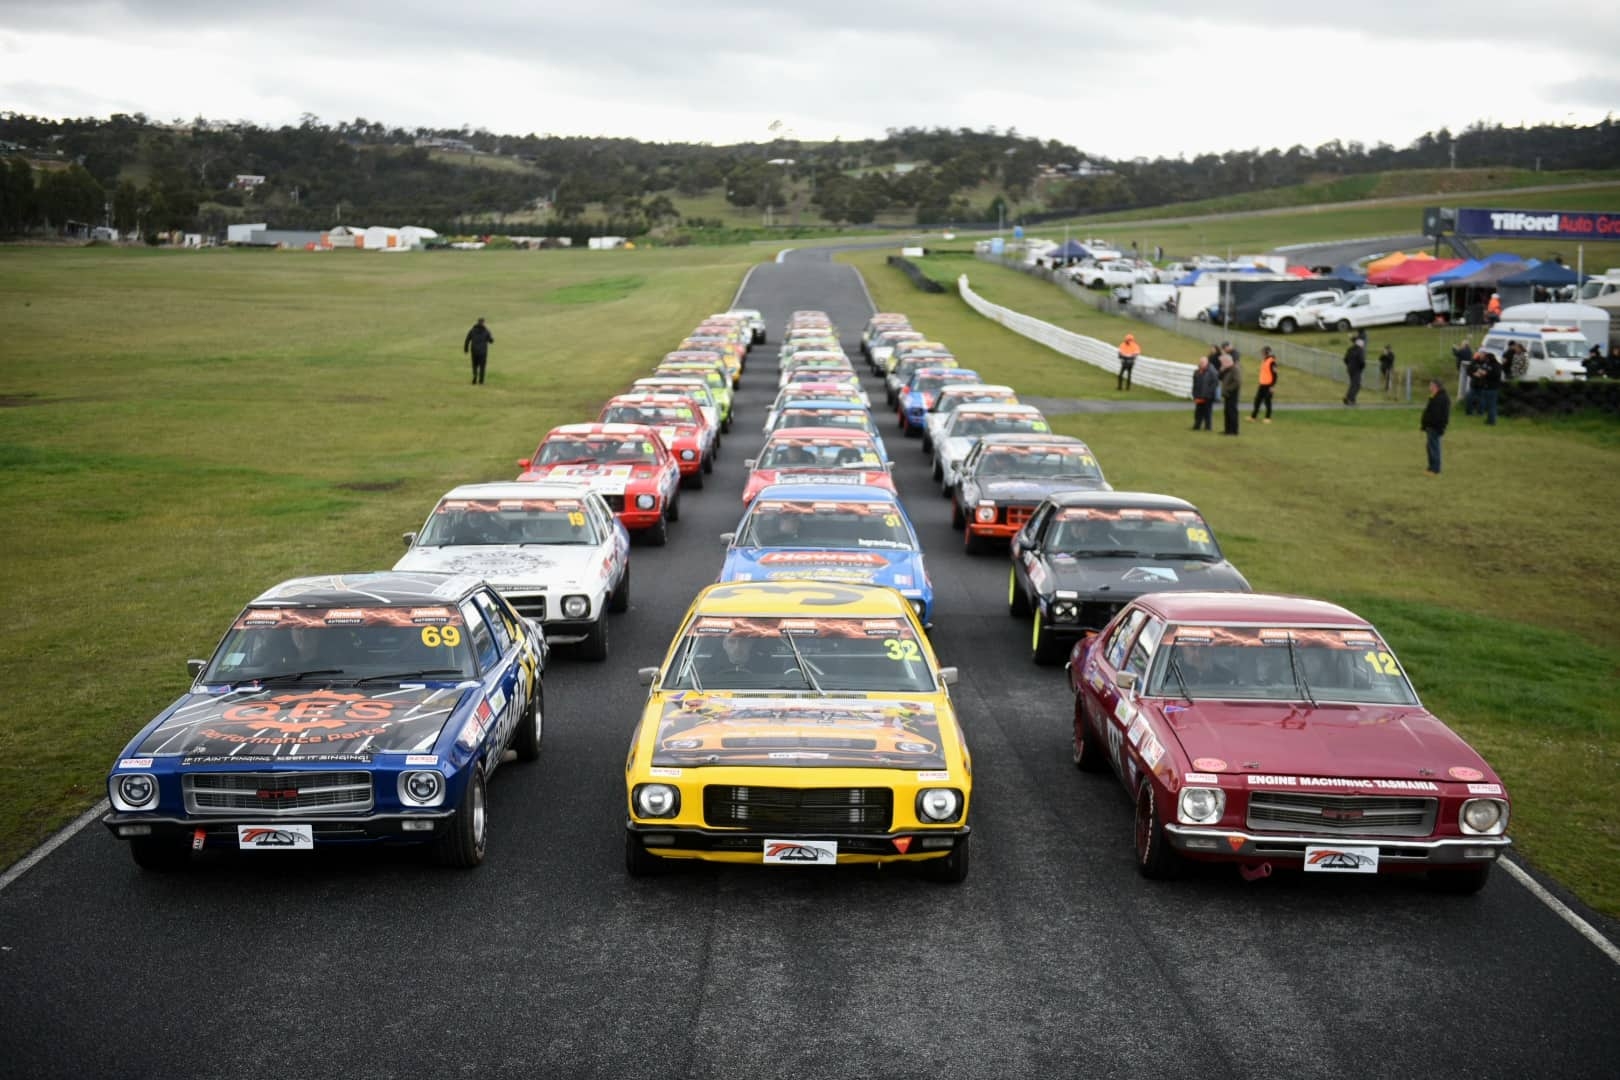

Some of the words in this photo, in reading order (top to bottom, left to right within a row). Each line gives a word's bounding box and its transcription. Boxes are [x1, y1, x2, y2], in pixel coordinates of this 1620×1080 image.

[1490, 213, 1558, 232] Tilford
[1560, 215, 1592, 232] Auto
[568, 512, 585, 526] 19
[421, 626, 461, 648] 69
[884, 639, 921, 661] 32
[1364, 651, 1401, 676] 12
[222, 702, 394, 721] QES
[199, 728, 322, 744] Performance
[1248, 775, 1297, 785] ENGINE
[1300, 776, 1373, 788] MACHINING
[1373, 779, 1438, 790] TASMANIA
